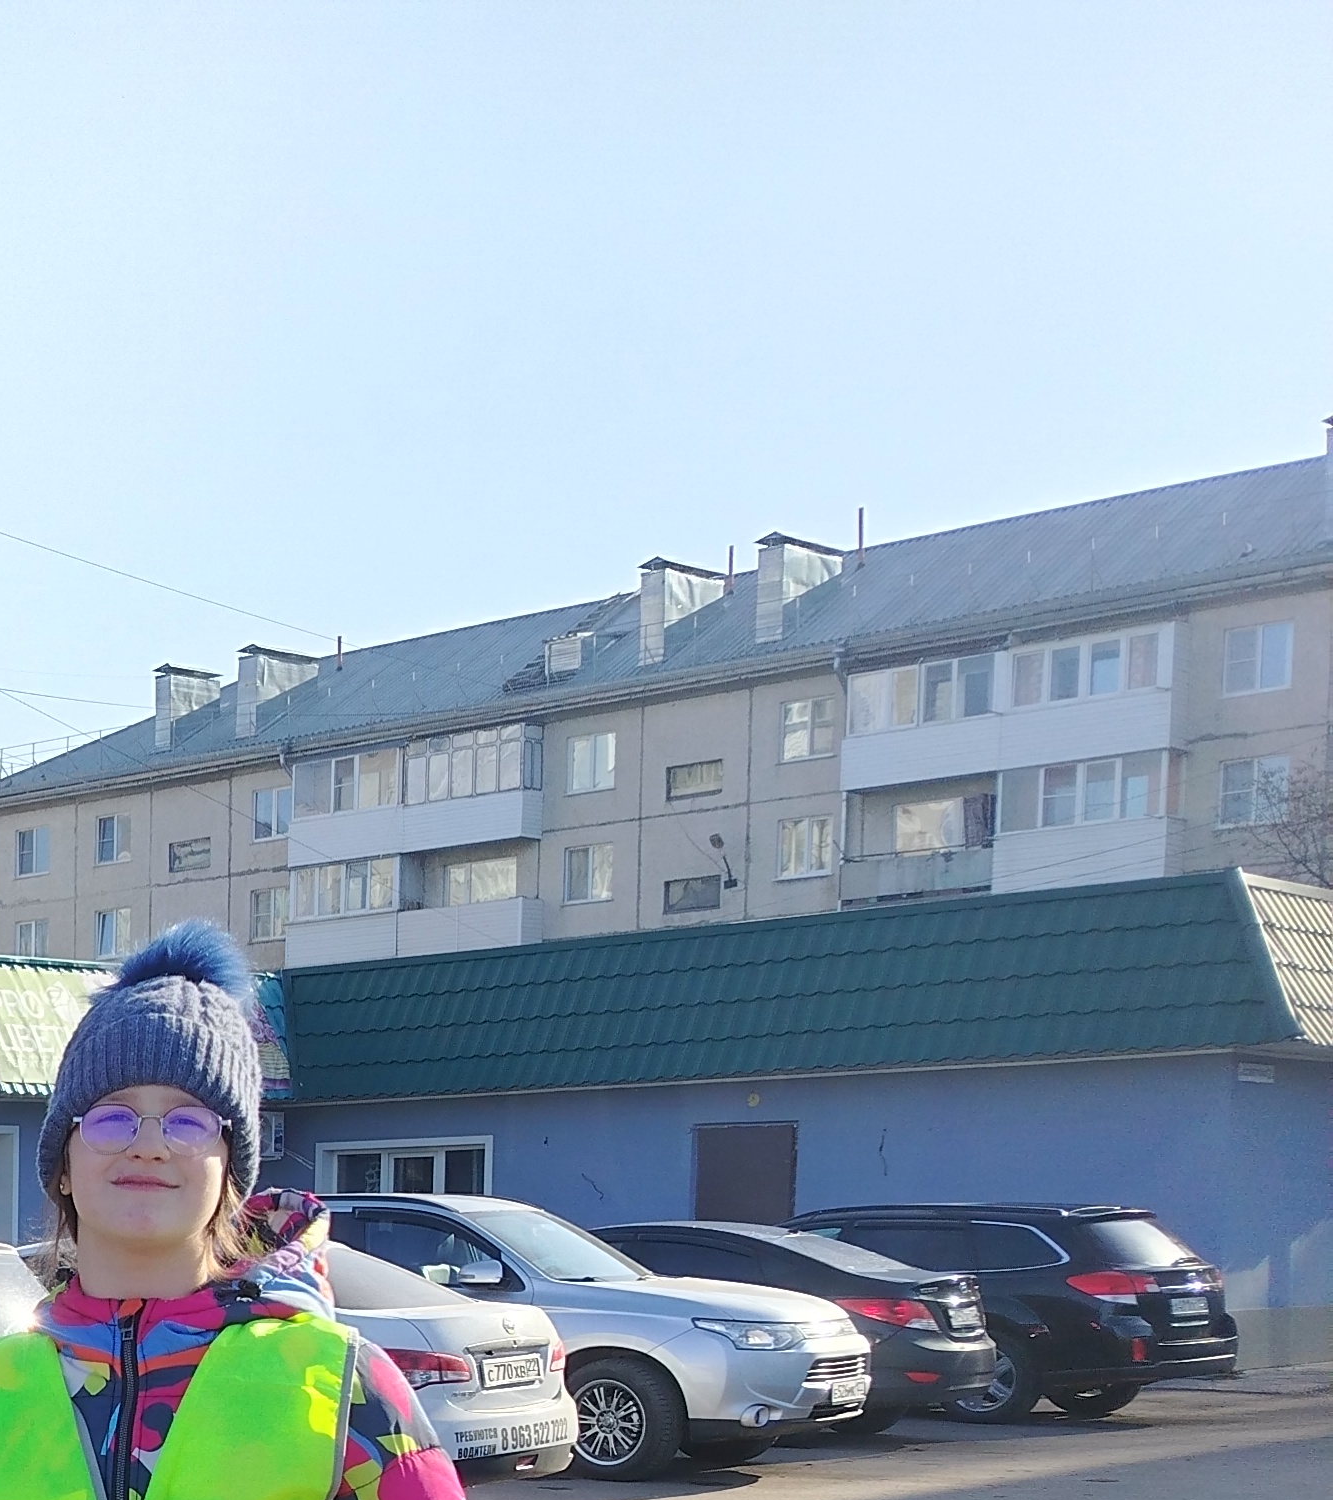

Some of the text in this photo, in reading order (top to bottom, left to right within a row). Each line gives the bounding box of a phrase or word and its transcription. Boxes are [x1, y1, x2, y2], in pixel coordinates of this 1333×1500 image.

[454, 1428, 498, 1443] ТРЕБУЮТСЯ
[501, 1428, 508, 1451] 8
[511, 1424, 532, 1449] 963
[533, 1421, 550, 1446] 522
[457, 1444, 497, 1459] ВОДИТЕЛИ
